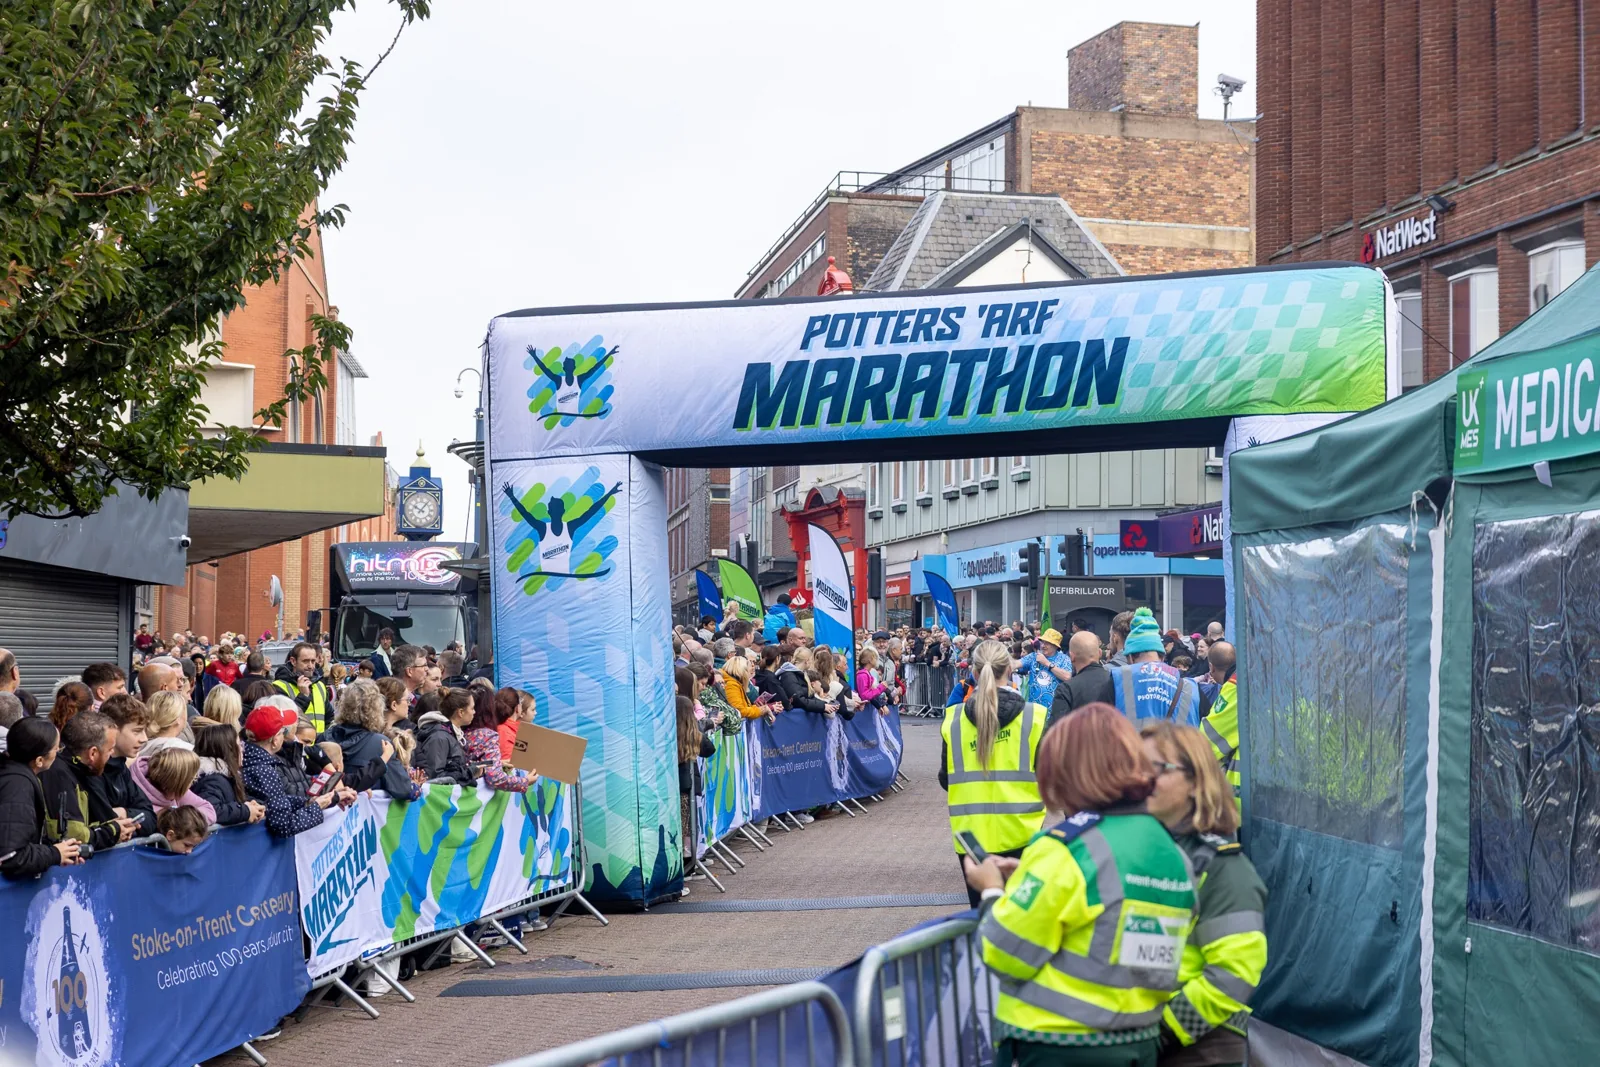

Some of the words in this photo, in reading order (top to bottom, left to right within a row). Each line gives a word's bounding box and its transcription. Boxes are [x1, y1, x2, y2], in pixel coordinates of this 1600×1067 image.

[1376, 209, 1436, 259] NatWest
[800, 306, 967, 351] POTTERS
[978, 299, 1060, 339] 'ARF
[733, 337, 1131, 430] MARATHON
[1462, 388, 1480, 427] UK
[1461, 428, 1479, 449] MES
[957, 557, 967, 580] The
[1049, 586, 1115, 595] DEFIBRILLATOR
[131, 910, 237, 961] Stoke-on-Trent
[52, 971, 88, 1015] 100
[157, 959, 219, 990] Celebrating
